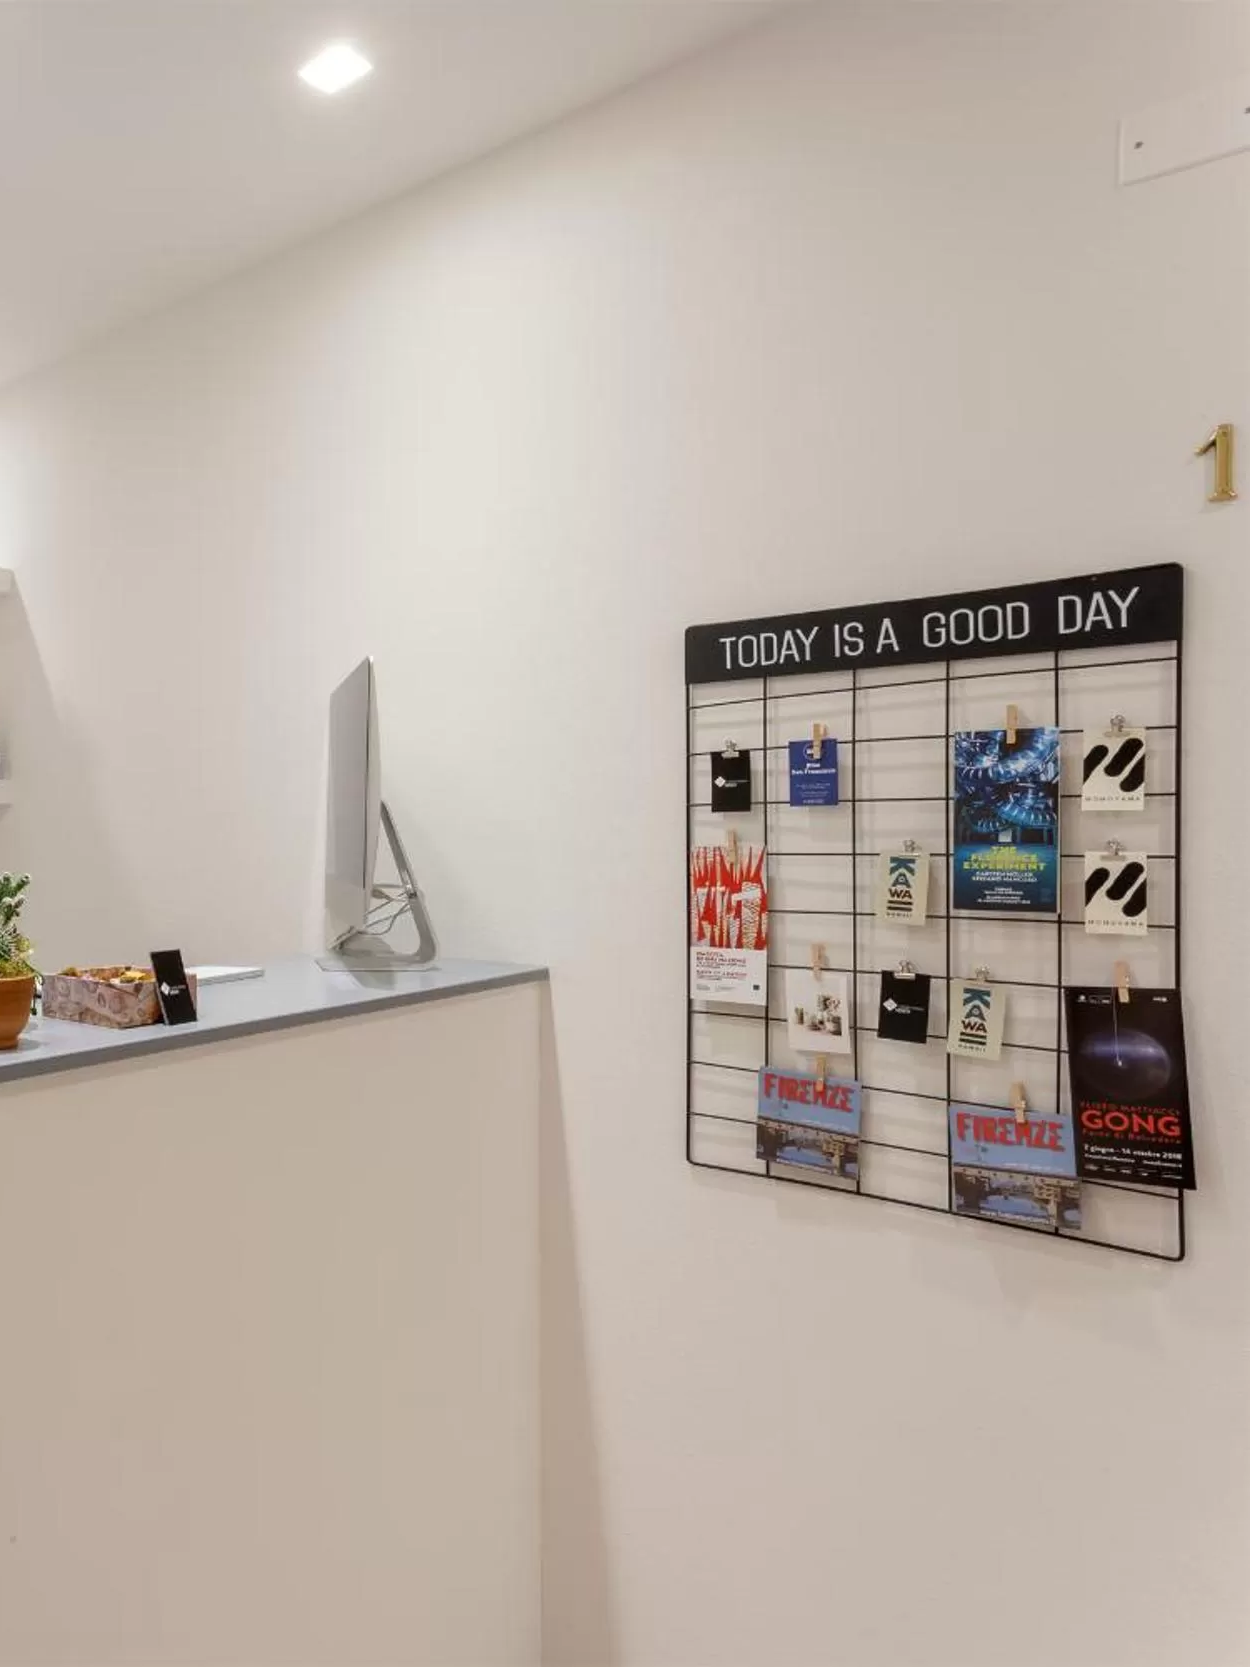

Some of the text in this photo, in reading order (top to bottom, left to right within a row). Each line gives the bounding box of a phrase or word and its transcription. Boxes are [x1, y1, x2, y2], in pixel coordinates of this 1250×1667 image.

[1193, 423, 1238, 502] 1
[718, 586, 1140, 670] TODAY IS A GOOD DAY
[962, 861, 1047, 871] EXPERIMENT
[764, 1073, 855, 1113] FIRENZE
[956, 1112, 1066, 1152] FIRENZE
[1081, 1110, 1181, 1136] GONG
